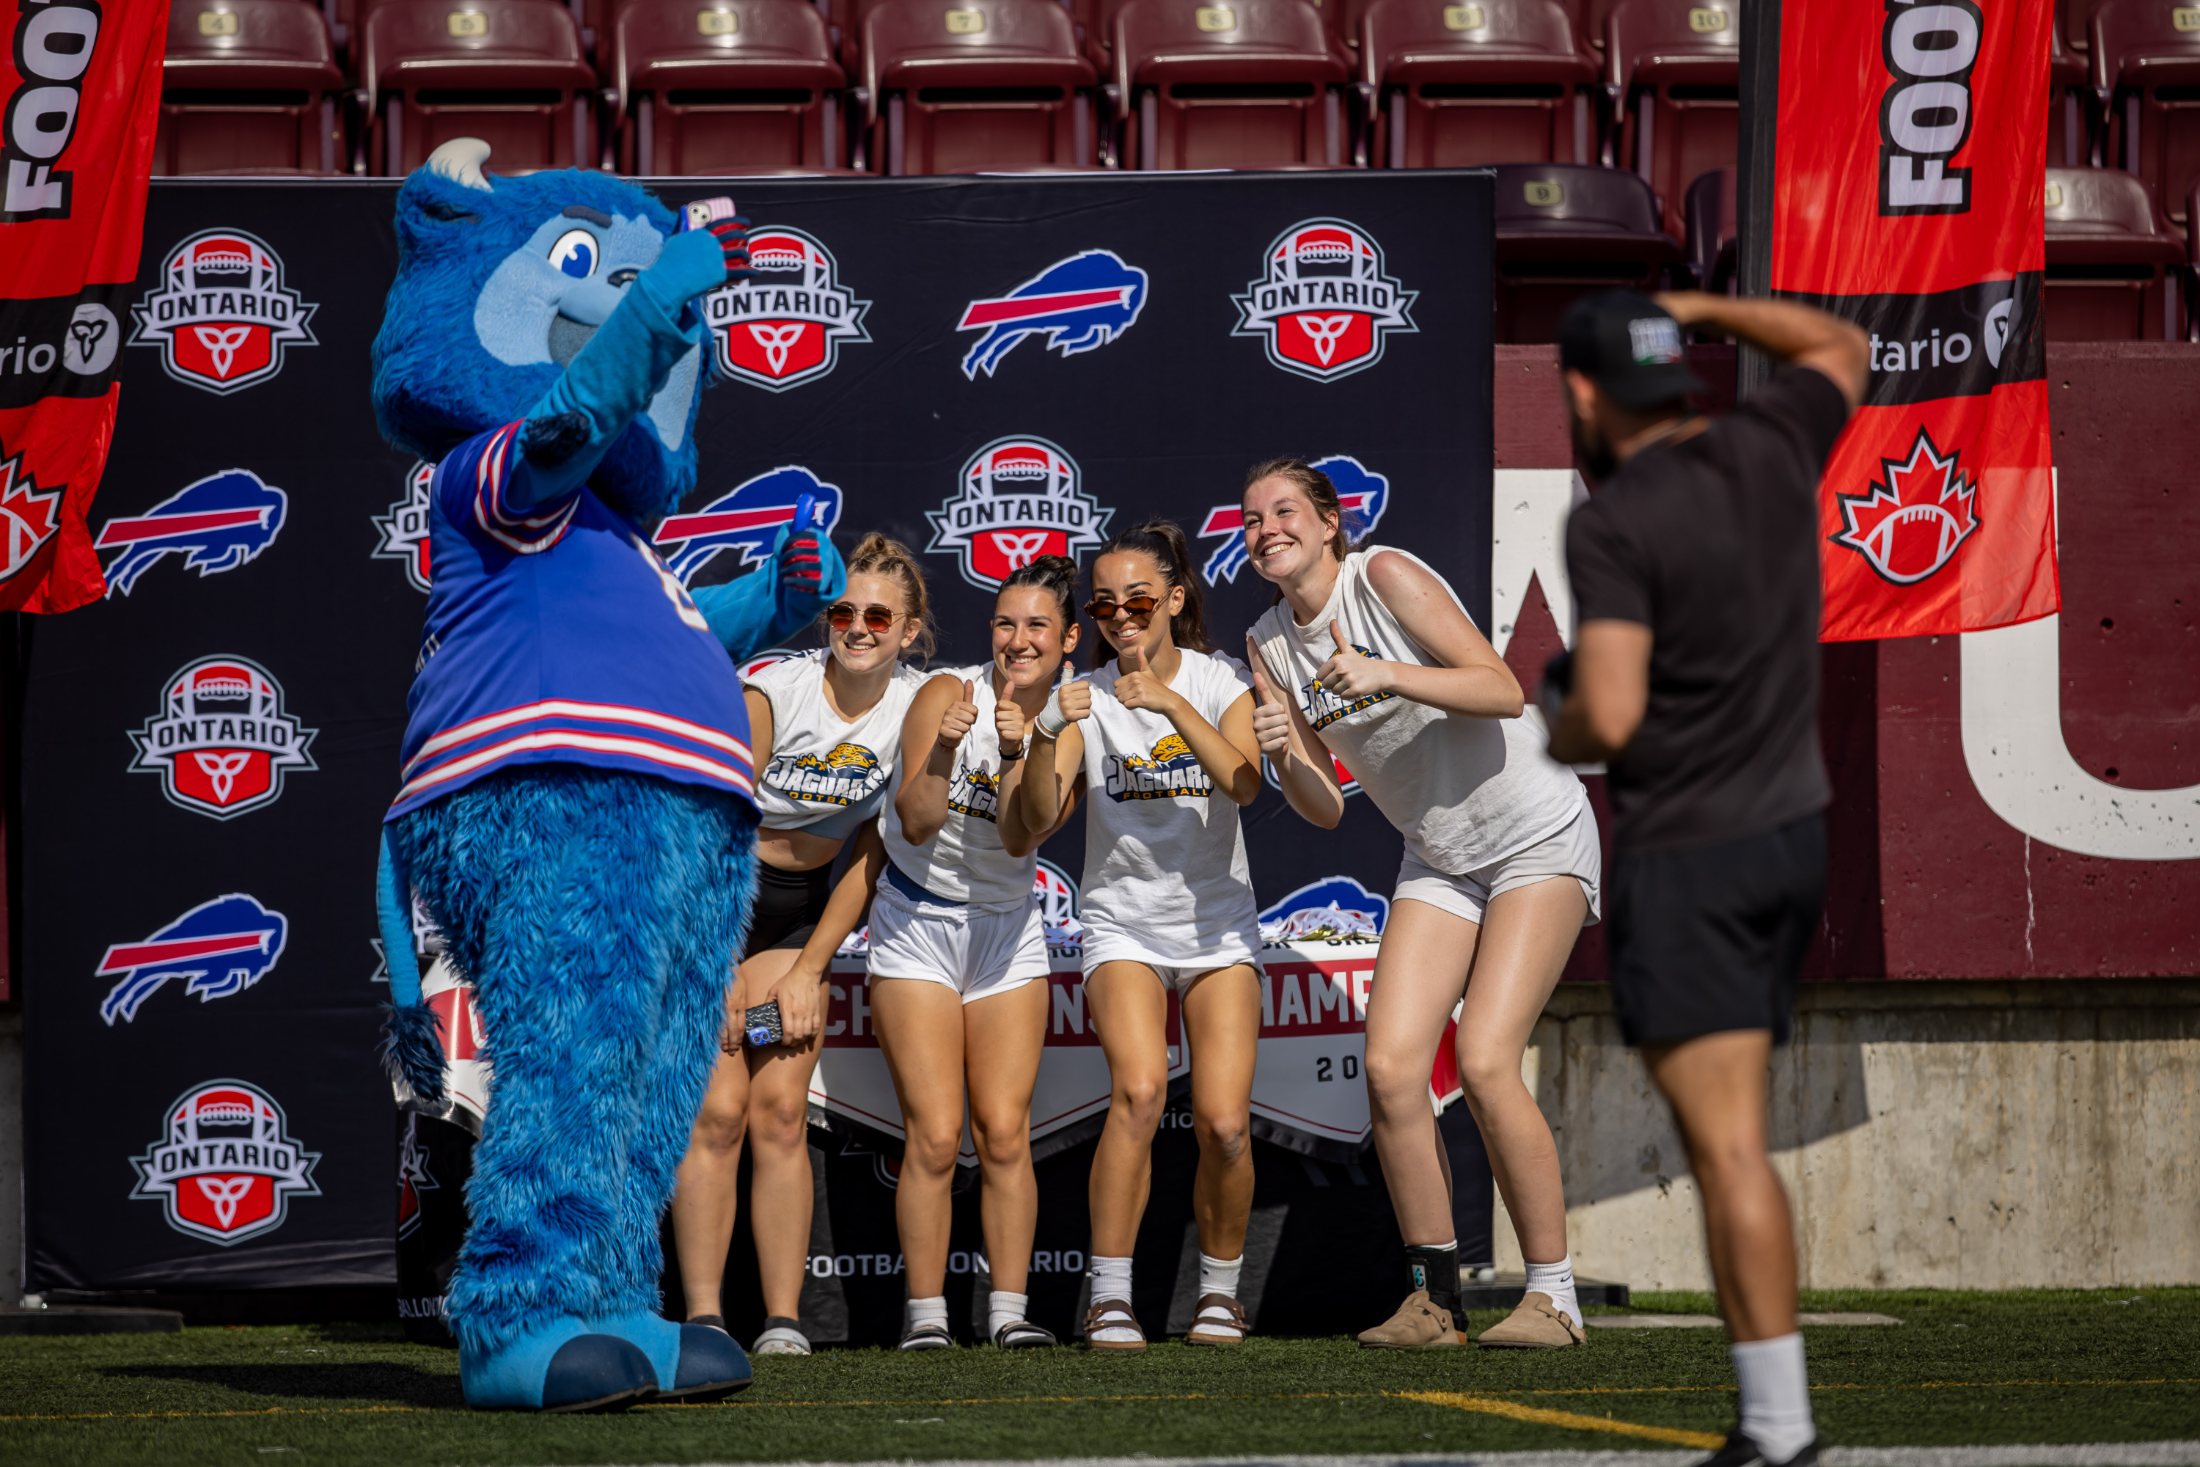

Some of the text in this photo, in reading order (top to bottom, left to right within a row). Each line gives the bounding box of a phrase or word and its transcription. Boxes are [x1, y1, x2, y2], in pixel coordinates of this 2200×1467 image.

[4, 0, 99, 212] FOO
[1888, 0, 1979, 207] FOO
[158, 291, 286, 321] ONTARIO
[713, 290, 841, 319] ONTARIO
[1261, 281, 1389, 311] ONTARIO
[1869, 328, 1972, 372] tario
[957, 499, 1085, 527] ONTARIO
[158, 719, 287, 749] ONTARIO
[785, 791, 858, 806] OOTBA
[161, 1142, 290, 1173] ONTARIO
